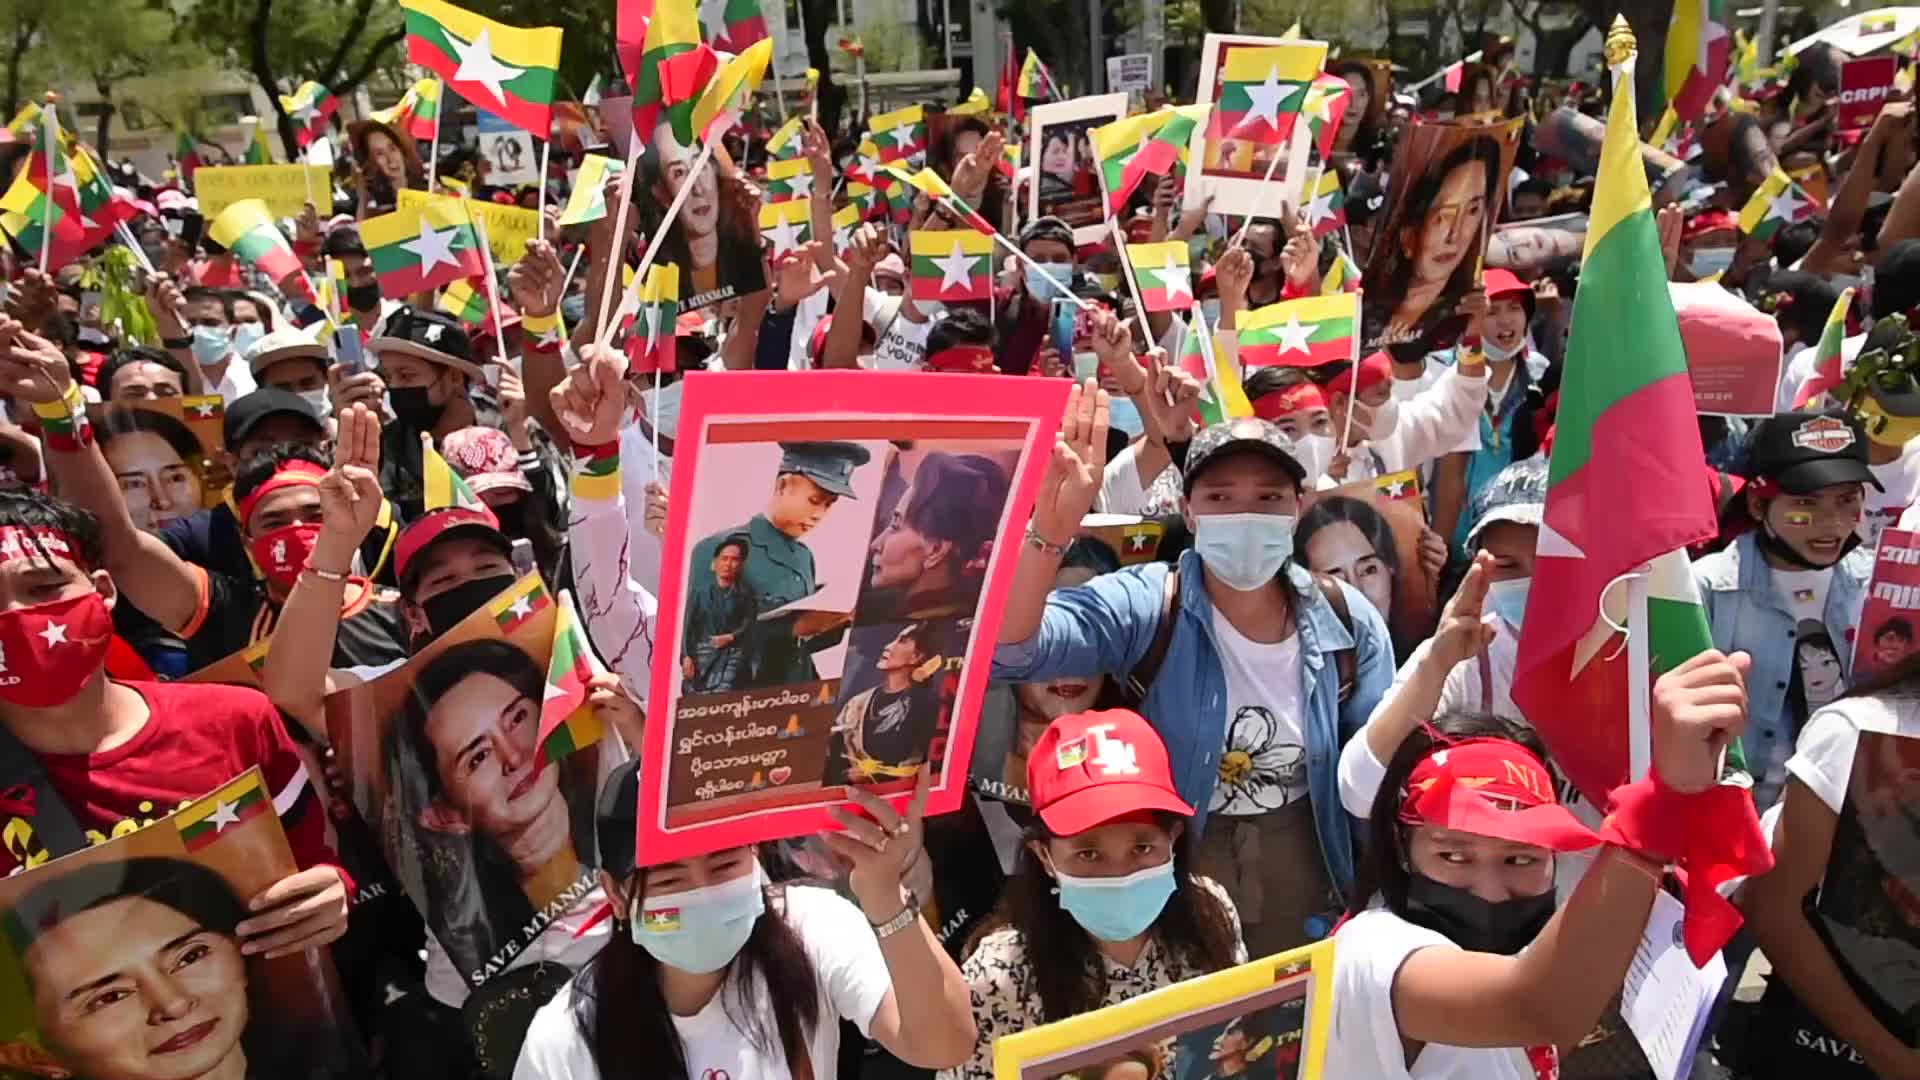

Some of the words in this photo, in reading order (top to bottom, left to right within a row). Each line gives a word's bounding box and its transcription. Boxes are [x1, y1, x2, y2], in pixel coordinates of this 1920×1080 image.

[887, 346, 913, 363] YOU
[472, 939, 521, 987] SAVE
[1795, 1029, 1865, 1065] SAVE
